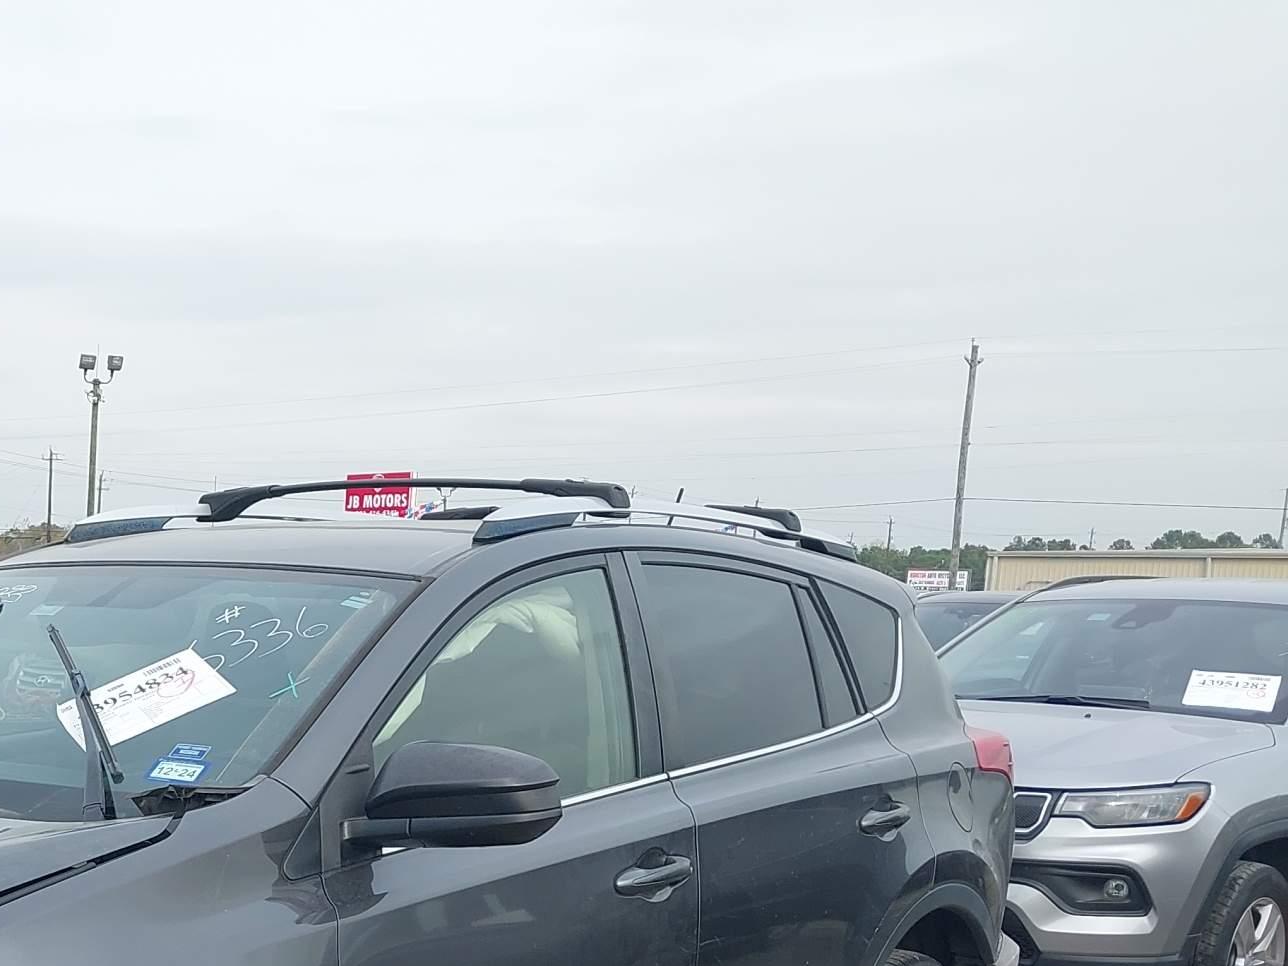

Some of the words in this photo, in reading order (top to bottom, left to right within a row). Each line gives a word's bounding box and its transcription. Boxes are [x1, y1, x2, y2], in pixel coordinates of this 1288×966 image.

[347, 495, 360, 509] JB
[363, 493, 408, 509] MOTORS
[78, 665, 189, 719] 3954834
[1198, 679, 1268, 690] 43951282
